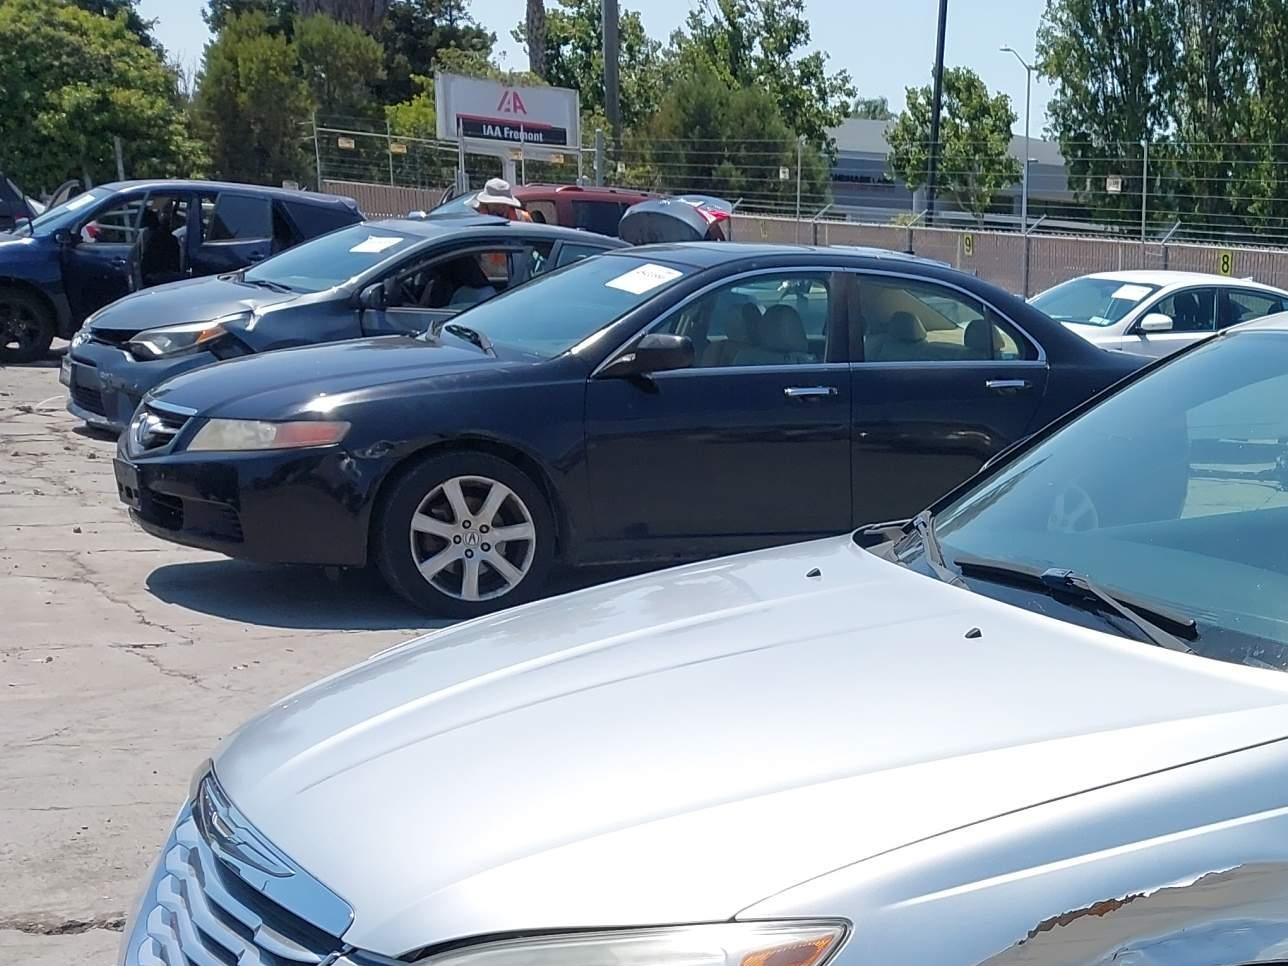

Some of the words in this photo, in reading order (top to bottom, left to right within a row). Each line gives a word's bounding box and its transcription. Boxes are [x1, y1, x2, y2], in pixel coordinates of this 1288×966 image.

[482, 124, 502, 138] IAA
[503, 126, 544, 143] Fremont
[1221, 254, 1230, 274] 8
